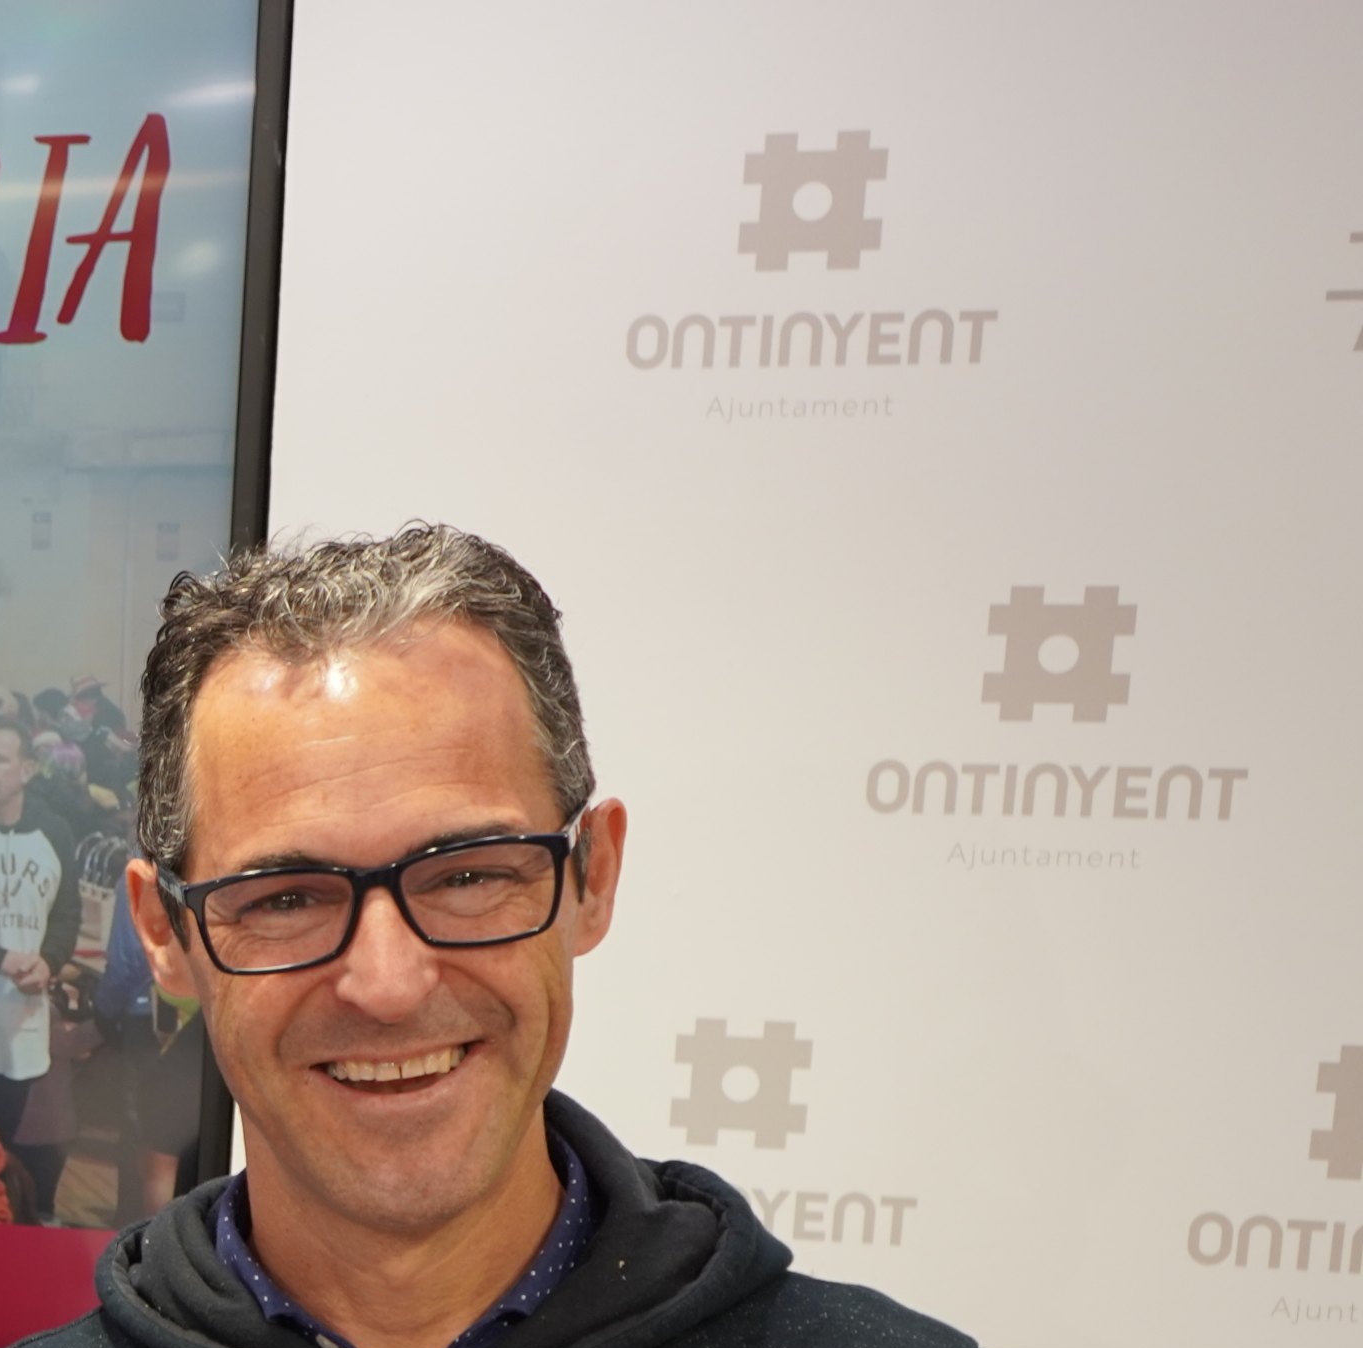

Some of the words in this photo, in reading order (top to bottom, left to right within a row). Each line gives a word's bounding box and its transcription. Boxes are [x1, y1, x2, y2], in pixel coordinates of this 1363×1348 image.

[625, 308, 999, 371] ONTINYENT
[705, 394, 894, 424] Ajuntament
[865, 759, 1249, 821] ONTINYENT
[946, 841, 1141, 870] Ajuntament
